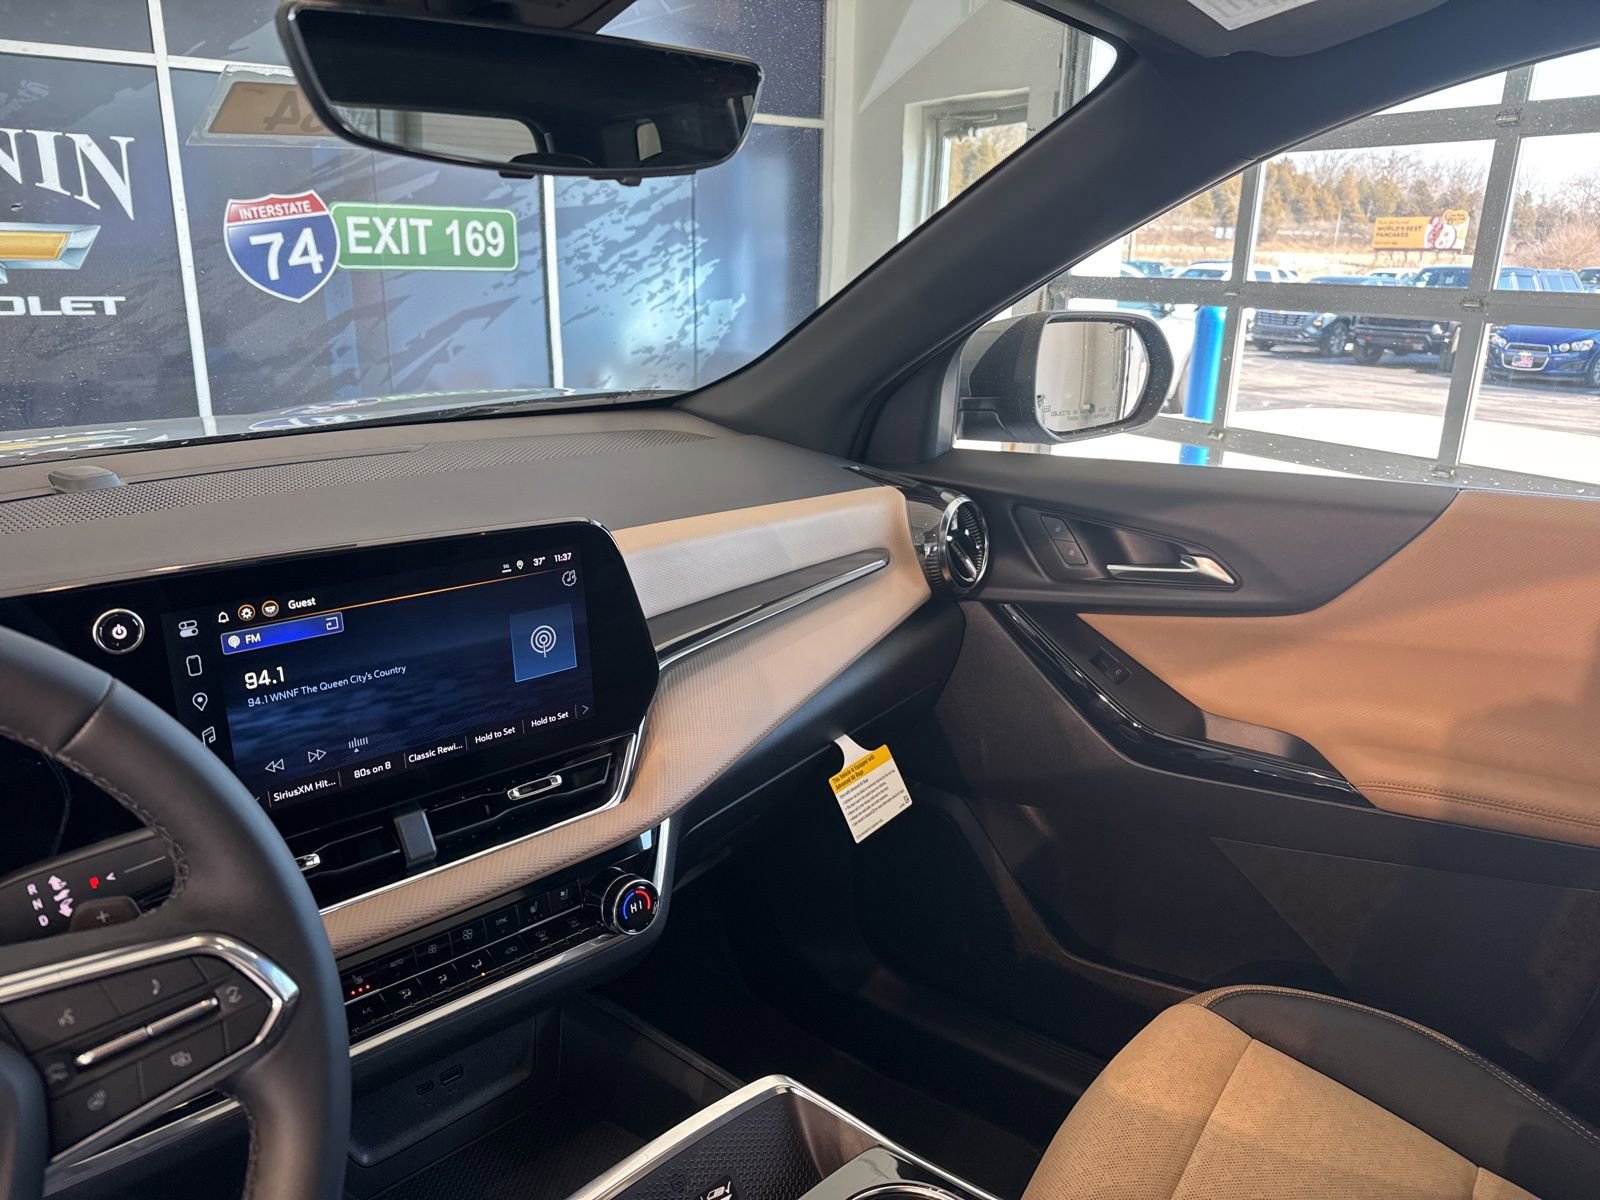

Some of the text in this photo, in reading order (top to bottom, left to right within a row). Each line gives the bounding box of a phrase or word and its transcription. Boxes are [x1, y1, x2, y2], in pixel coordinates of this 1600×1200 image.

[238, 200, 313, 220] INTERSTATE
[345, 215, 506, 257] EXIT 169
[249, 226, 324, 281] 74
[554, 552, 572, 563] 11:37
[288, 597, 316, 610] Guest
[245, 633, 261, 644] FM
[244, 666, 285, 690] 94.1
[247, 665, 407, 708] 94.1 WNNF The Queen City's Country
[530, 711, 569, 728] Hold to Set
[474, 726, 516, 744] Hold to Set
[408, 749, 436, 764] Classic
[353, 761, 392, 780] 80s on 8
[832, 775, 840, 784] This
[839, 768, 852, 779] Vehicle
[835, 776, 851, 790] Advanced
[273, 784, 313, 802] SiriusXM
[27, 883, 38, 895] R
[32, 898, 43, 911] N
[38, 914, 49, 927] D
